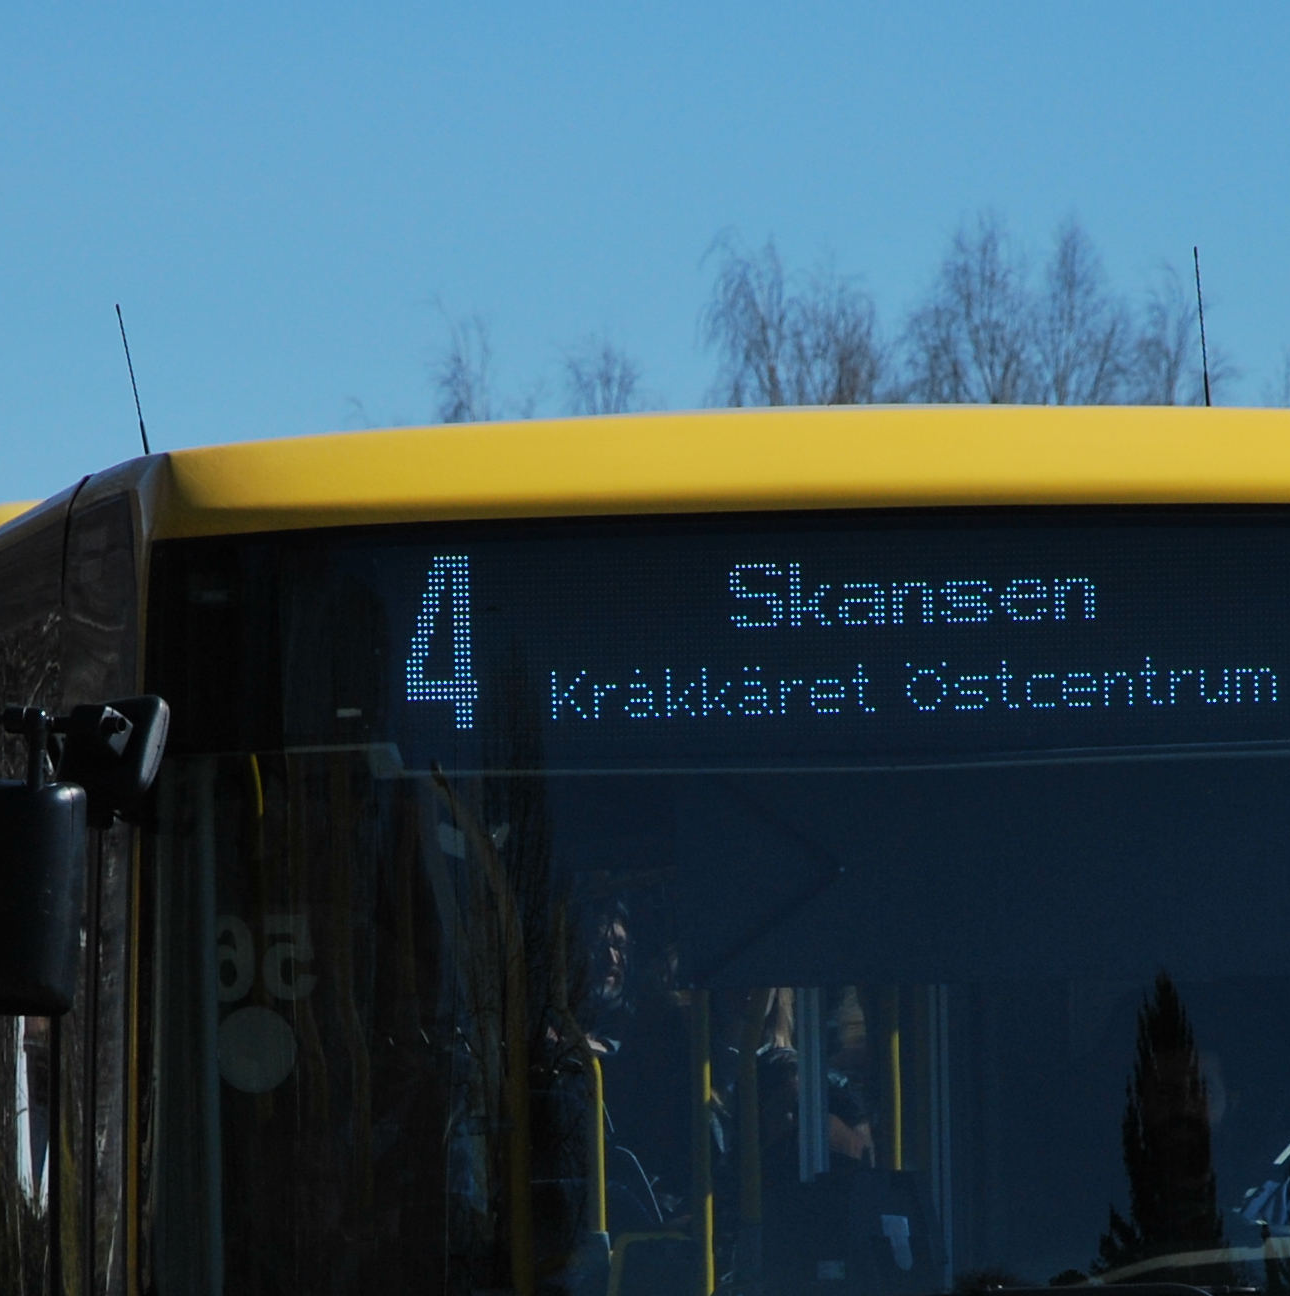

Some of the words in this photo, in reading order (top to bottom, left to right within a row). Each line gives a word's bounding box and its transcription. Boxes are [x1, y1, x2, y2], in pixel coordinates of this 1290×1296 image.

[728, 560, 1097, 628] Skansen
[406, 555, 479, 731] 4
[905, 655, 1277, 712] Östcentrum
